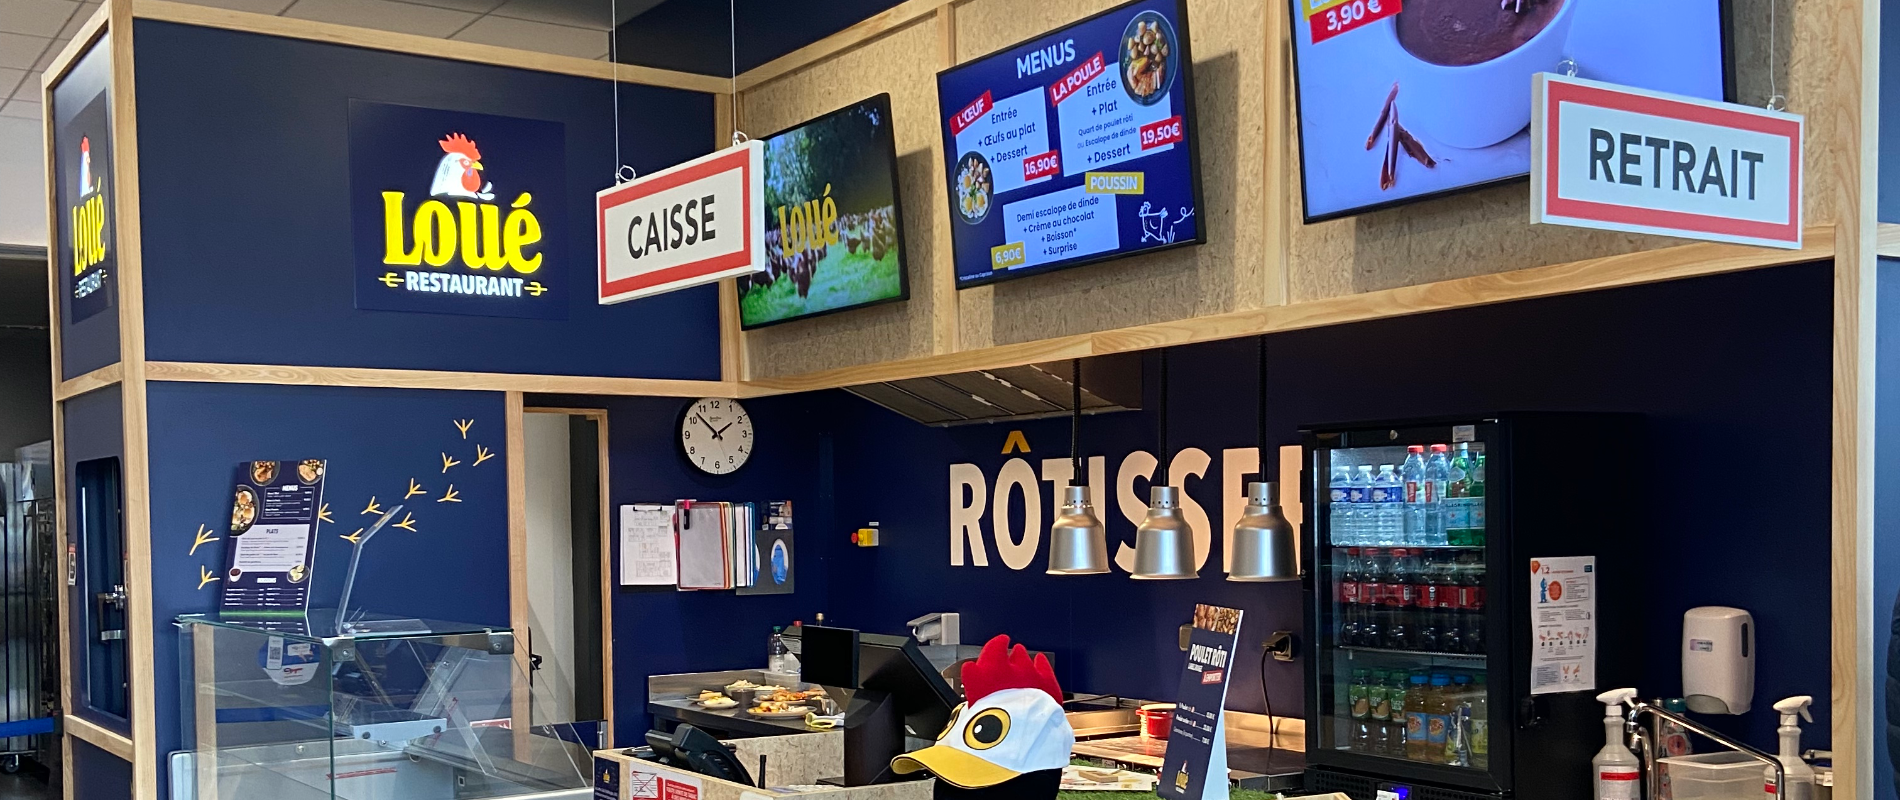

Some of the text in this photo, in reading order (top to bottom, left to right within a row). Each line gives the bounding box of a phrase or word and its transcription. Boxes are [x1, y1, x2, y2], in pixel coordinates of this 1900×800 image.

[1327, 0, 1364, 31] 3,90
[1016, 39, 1076, 79] MENUS
[1052, 56, 1102, 101] LA POULE
[1087, 78, 1117, 97] Entrée
[991, 107, 1018, 125] Entrée
[1099, 100, 1118, 115] Plat
[984, 131, 1005, 147] Œufs
[1006, 128, 1018, 140] au
[1019, 121, 1036, 141] plat
[1078, 125, 1095, 137] Quart
[1095, 122, 1103, 132] de
[1103, 117, 1122, 132] poulet
[1085, 132, 1111, 147] Escalope
[1111, 129, 1119, 139] de
[1119, 125, 1137, 137] dinde
[1142, 122, 1180, 145] 19,50€
[996, 145, 1028, 163] Dessert
[1094, 143, 1131, 163] Dessert
[1024, 155, 1058, 175] 16,90€
[1589, 128, 1764, 200] RETRAIT
[1090, 176, 1138, 190] POUSSIN
[1016, 196, 1099, 223] Demi escalope de dinde
[73, 176, 106, 276] Loué
[627, 194, 716, 259] CAISSE
[778, 183, 839, 258] Loué
[1028, 220, 1051, 233] Crème
[1052, 218, 1062, 228] au
[1062, 210, 1095, 224] chocolat
[381, 191, 543, 274] Loué
[995, 247, 1021, 264] 6,90€
[1048, 242, 1078, 256] Surprise
[405, 271, 524, 297] RESTAURANT
[698, 404, 706, 412] 11
[710, 401, 719, 409] 12
[728, 404, 733, 412] 1
[689, 416, 697, 425] 10
[737, 415, 743, 424] 2
[684, 430, 690, 439] 9
[742, 430, 747, 438] 3
[689, 446, 695, 454] 8
[738, 445, 743, 453] 4
[714, 461, 720, 469] 6
[1190, 643, 1213, 665] POULET
[1211, 645, 1228, 668] RÔTI
